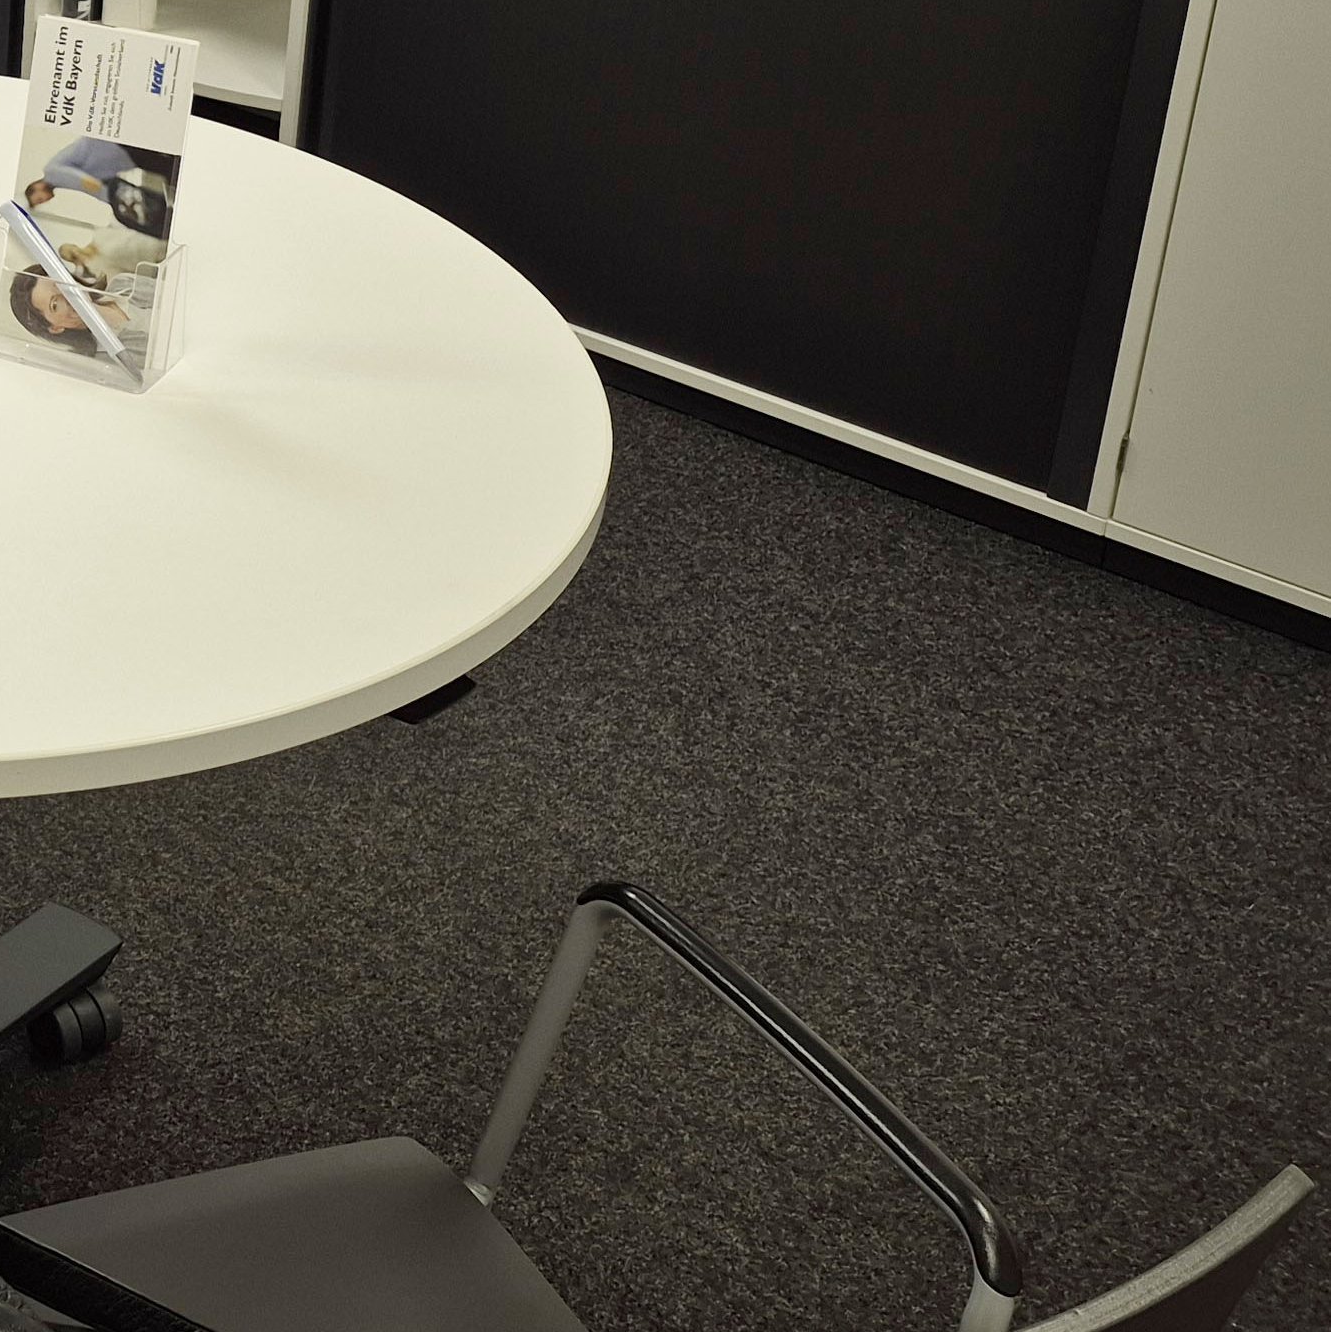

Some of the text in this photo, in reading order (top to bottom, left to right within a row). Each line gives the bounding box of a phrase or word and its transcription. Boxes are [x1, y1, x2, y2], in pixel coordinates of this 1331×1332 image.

[44, 26, 69, 124] Ehrenamt im
[59, 39, 84, 127] VdK Bayern
[151, 59, 166, 95] VdK
